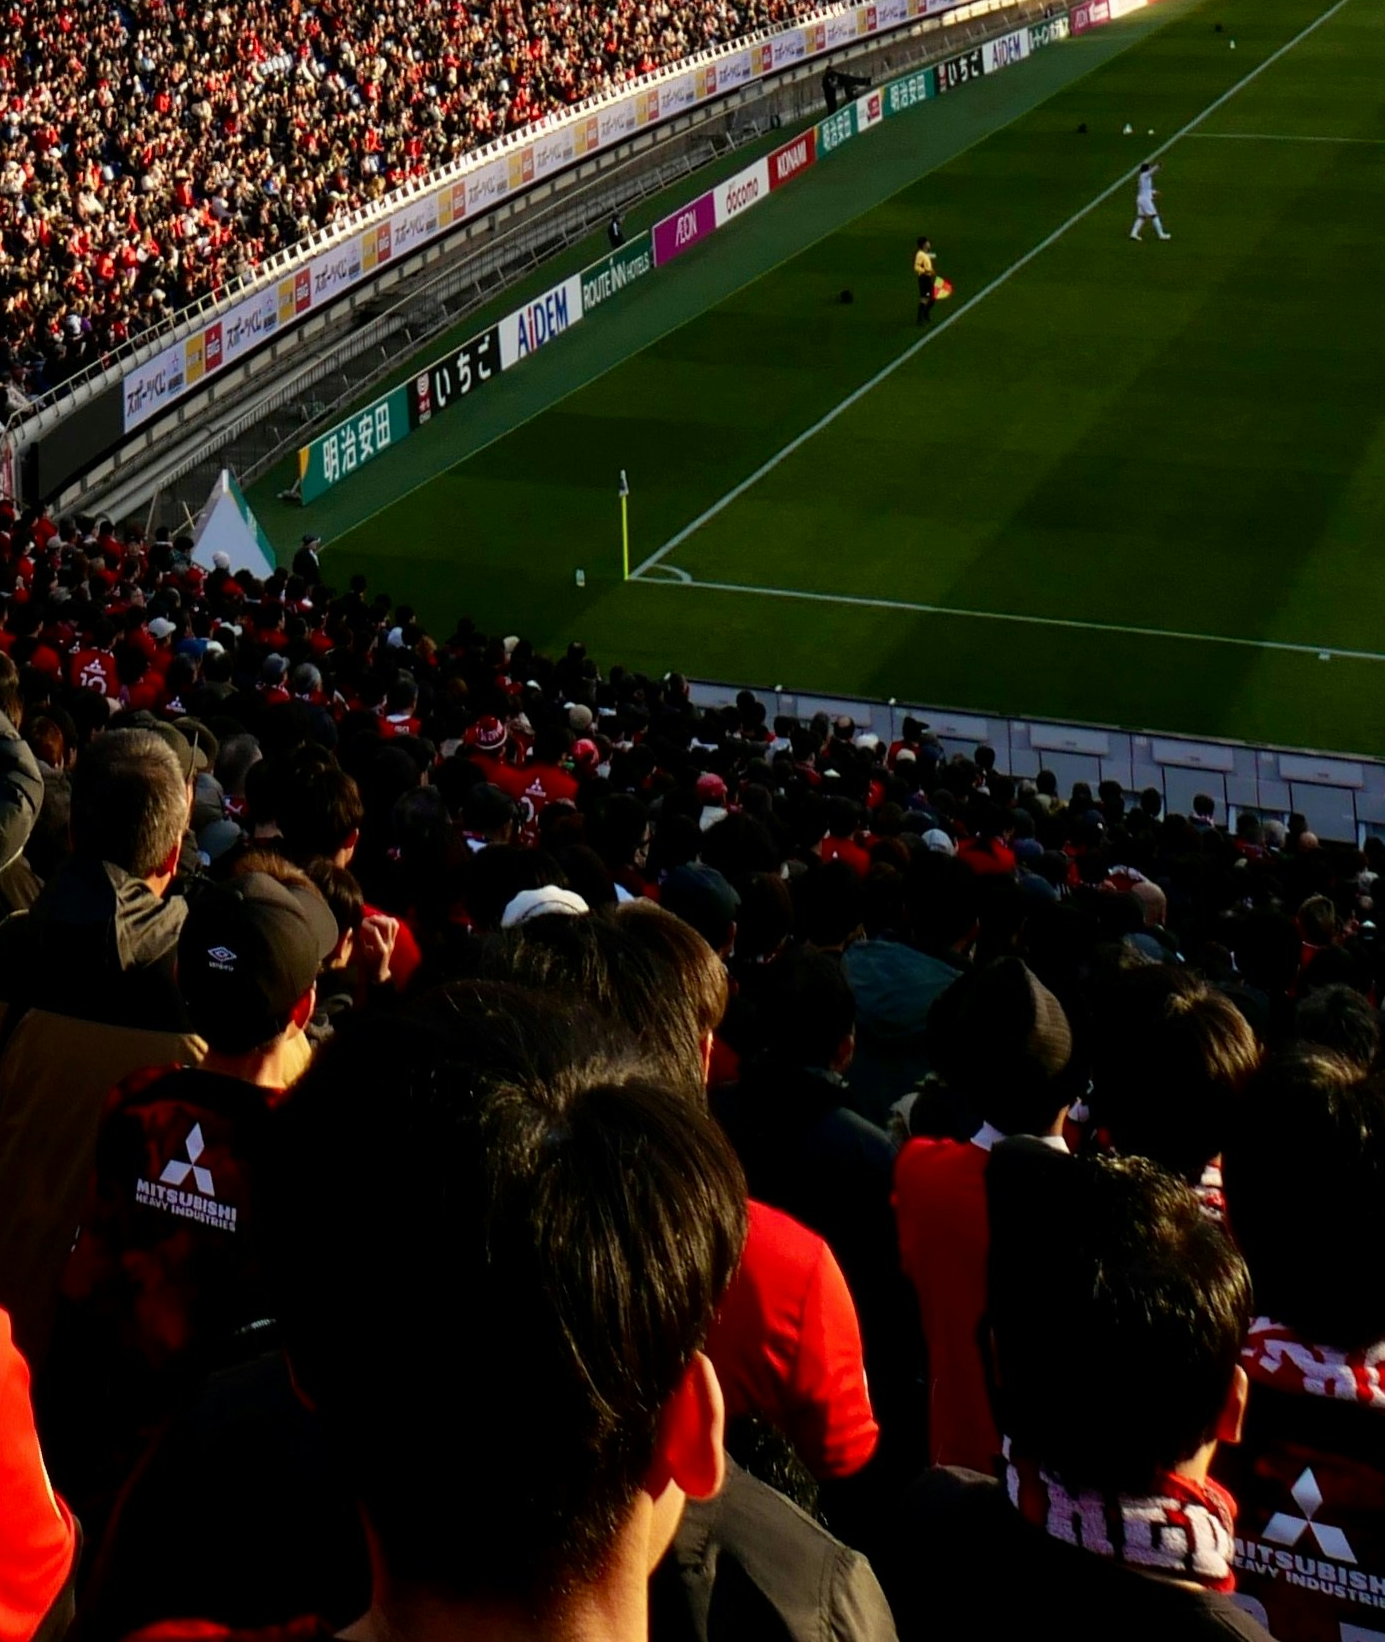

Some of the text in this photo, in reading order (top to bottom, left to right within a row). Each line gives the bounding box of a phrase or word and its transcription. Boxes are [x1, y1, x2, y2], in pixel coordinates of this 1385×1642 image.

[947, 49, 980, 87] いちご
[777, 139, 808, 179] KONAMI
[726, 177, 759, 214] docomo
[583, 270, 612, 312] ROUTE
[435, 334, 492, 407] いちご
[322, 402, 391, 484] 明治安田
[135, 1192, 237, 1234] HEAVY INDUSTRIES
[136, 1177, 238, 1222] MITSUBISHI
